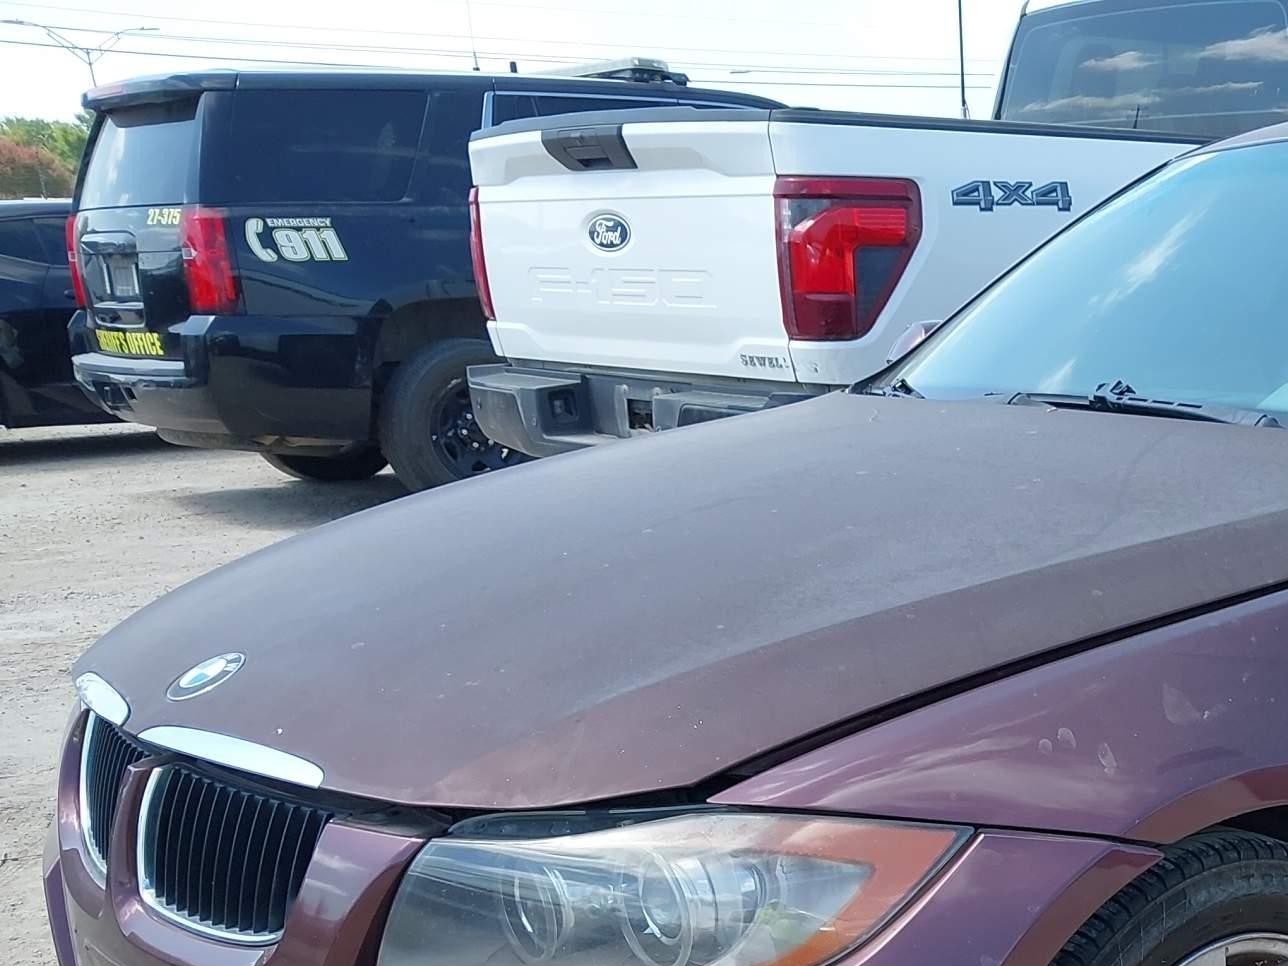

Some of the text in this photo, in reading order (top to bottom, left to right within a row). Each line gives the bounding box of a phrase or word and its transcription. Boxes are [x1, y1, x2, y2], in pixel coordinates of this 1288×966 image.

[147, 208, 182, 224] 27-375
[265, 217, 332, 227] EMERGENCY
[593, 219, 622, 245] Ford
[272, 227, 349, 262] 911
[126, 332, 165, 355] OFFICE
